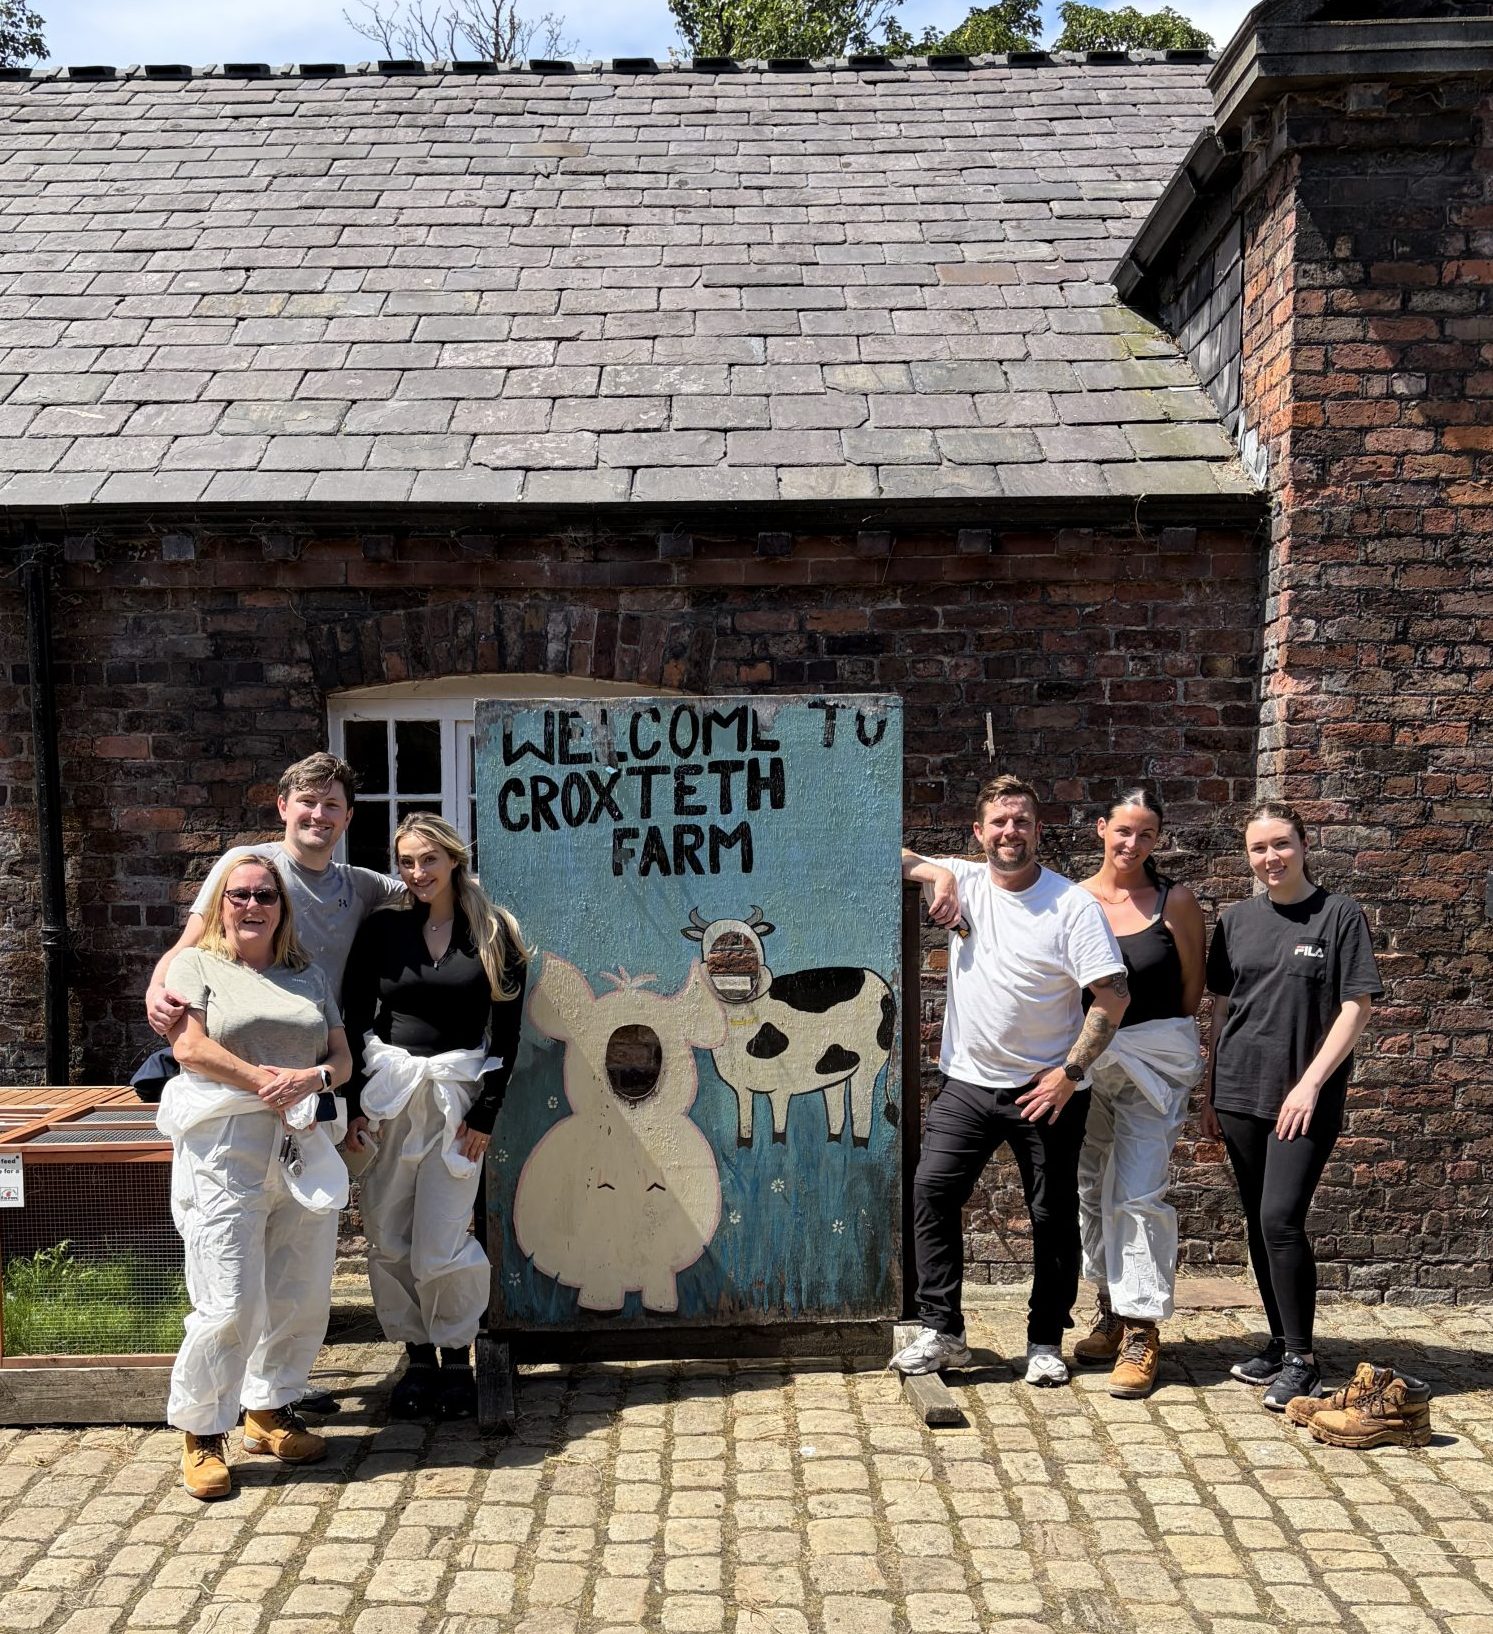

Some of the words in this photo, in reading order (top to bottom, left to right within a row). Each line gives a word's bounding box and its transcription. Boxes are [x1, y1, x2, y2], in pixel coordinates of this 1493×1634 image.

[498, 757, 786, 832] CROXTETH
[612, 820, 754, 877] FARM
[1294, 944, 1324, 958] FILA
